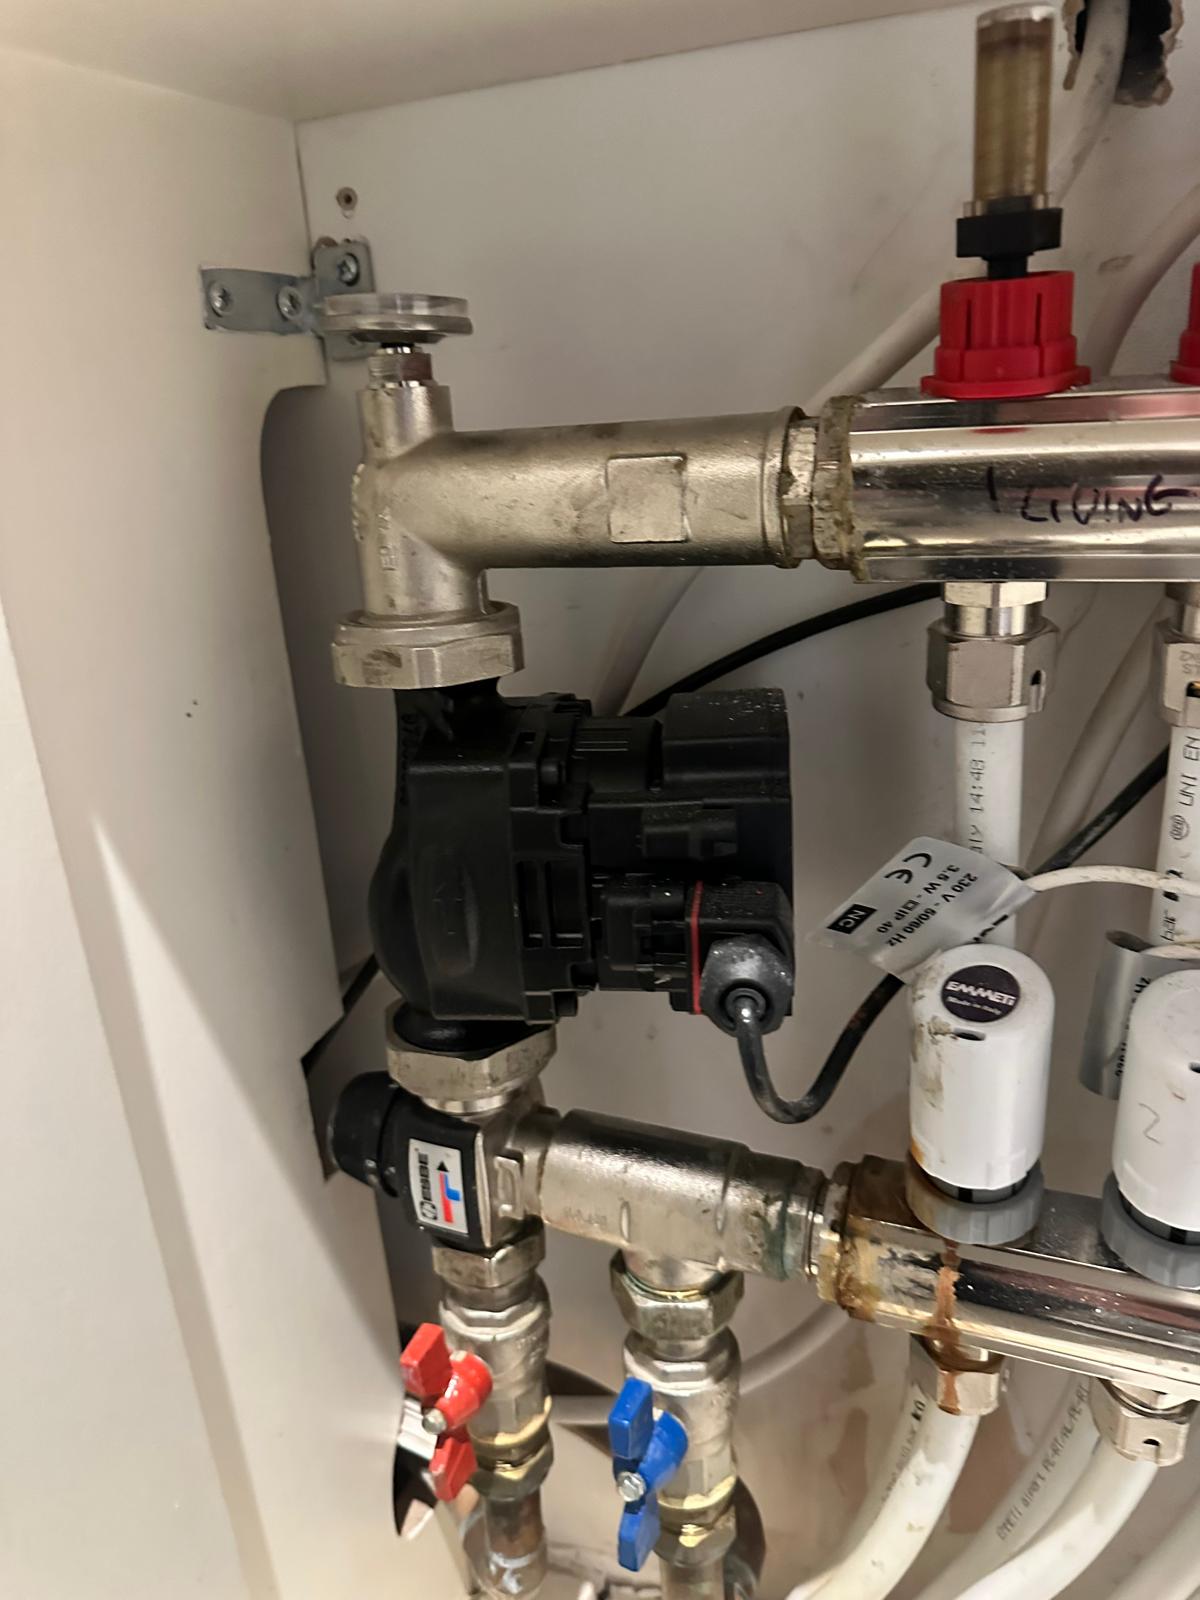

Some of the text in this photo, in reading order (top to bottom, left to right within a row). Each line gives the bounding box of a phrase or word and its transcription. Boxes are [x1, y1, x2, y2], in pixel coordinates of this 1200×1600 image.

[1021, 474, 1198, 525] LIVING
[1183, 735, 1200, 761] EN
[1179, 774, 1198, 807] UNI
[923, 881, 941, 895] W
[951, 872, 979, 894] 230
[941, 892, 956, 903] V
[838, 909, 866, 930] NC
[876, 921, 894, 934] 40
[887, 934, 907, 947] Hz
